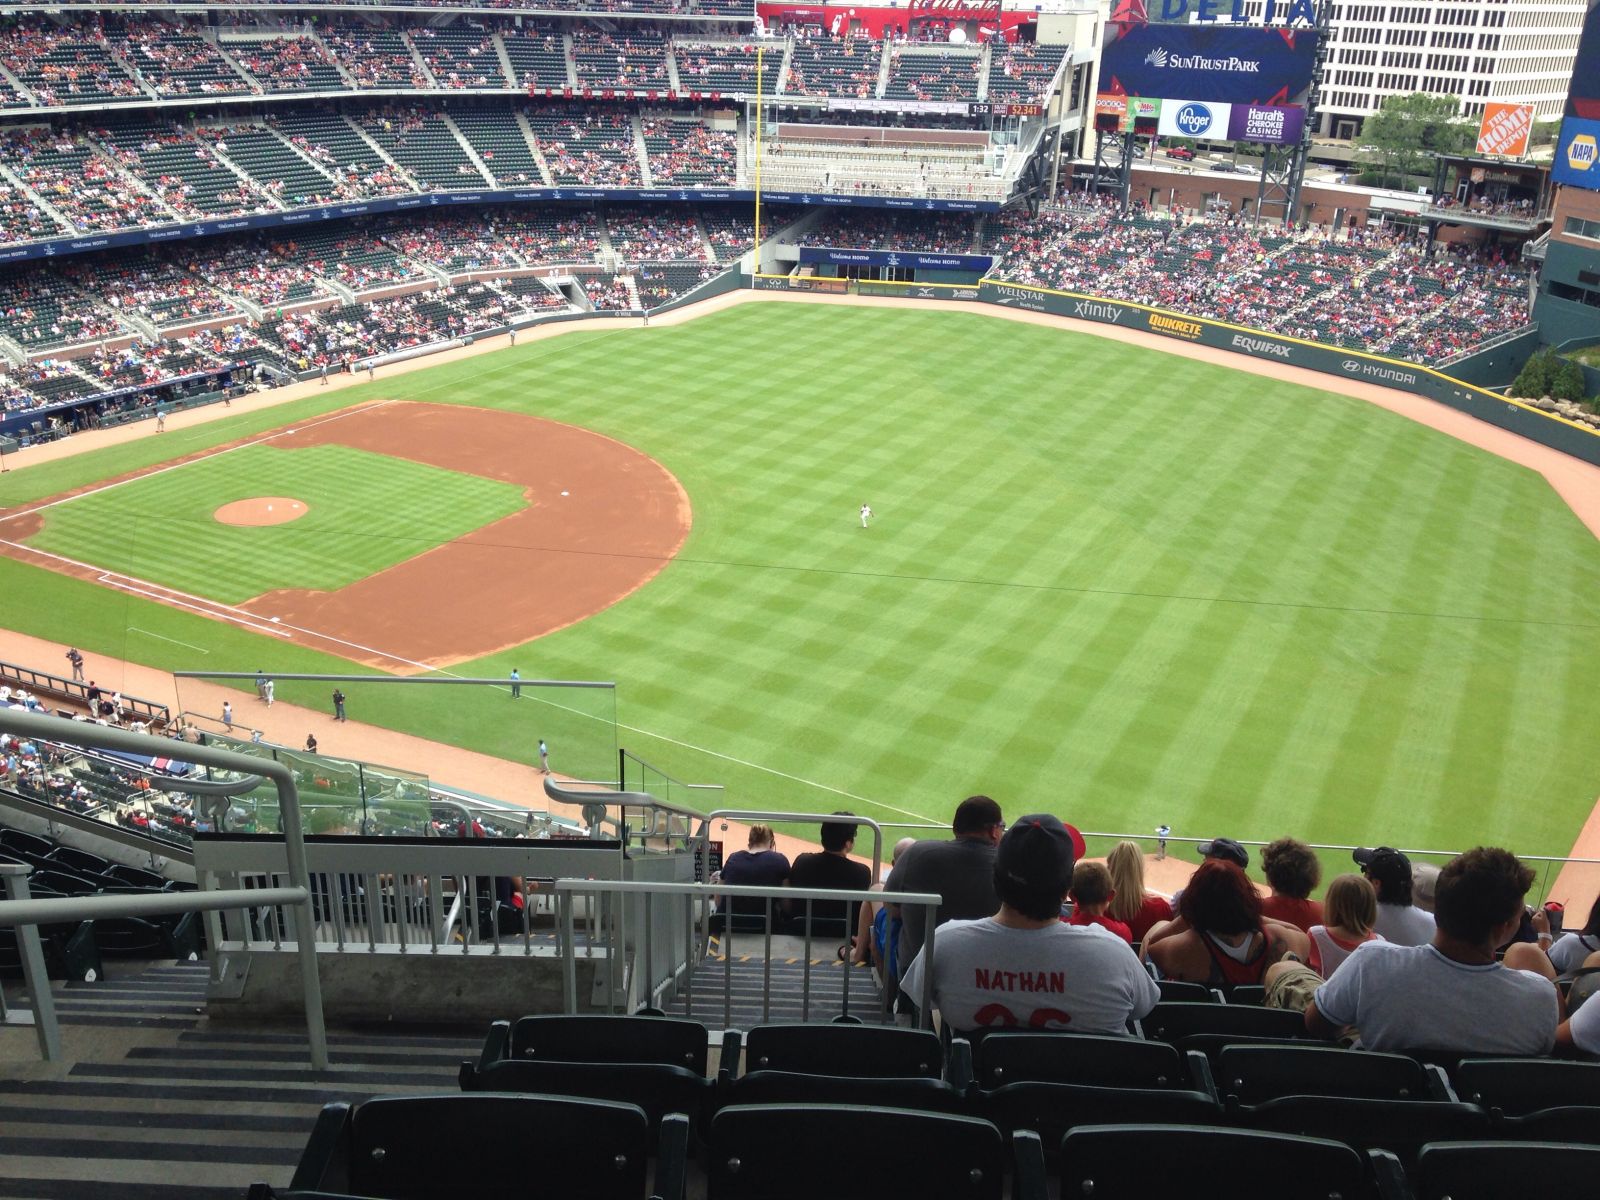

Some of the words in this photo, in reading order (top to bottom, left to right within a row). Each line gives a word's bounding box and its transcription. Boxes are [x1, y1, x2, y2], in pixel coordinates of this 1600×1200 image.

[733, 92, 744, 102] 42
[1179, 107, 1210, 133] Kroger
[1247, 119, 1283, 129] CHEROKEE
[1248, 107, 1284, 121] Harrah's
[1487, 109, 1508, 128] THE
[1246, 127, 1282, 136] CASINOS
[1478, 105, 1531, 152] HOME
[1496, 124, 1529, 154] DEPOT
[1571, 143, 1593, 162] NAPA
[997, 286, 1044, 301] WELLSTAR
[1074, 300, 1122, 322] xfinity
[1148, 313, 1202, 335] QUIKRETE
[1231, 334, 1291, 358] EQUIFAX
[1362, 364, 1416, 385] HYUNDAI
[975, 968, 1065, 993] NATHAN
